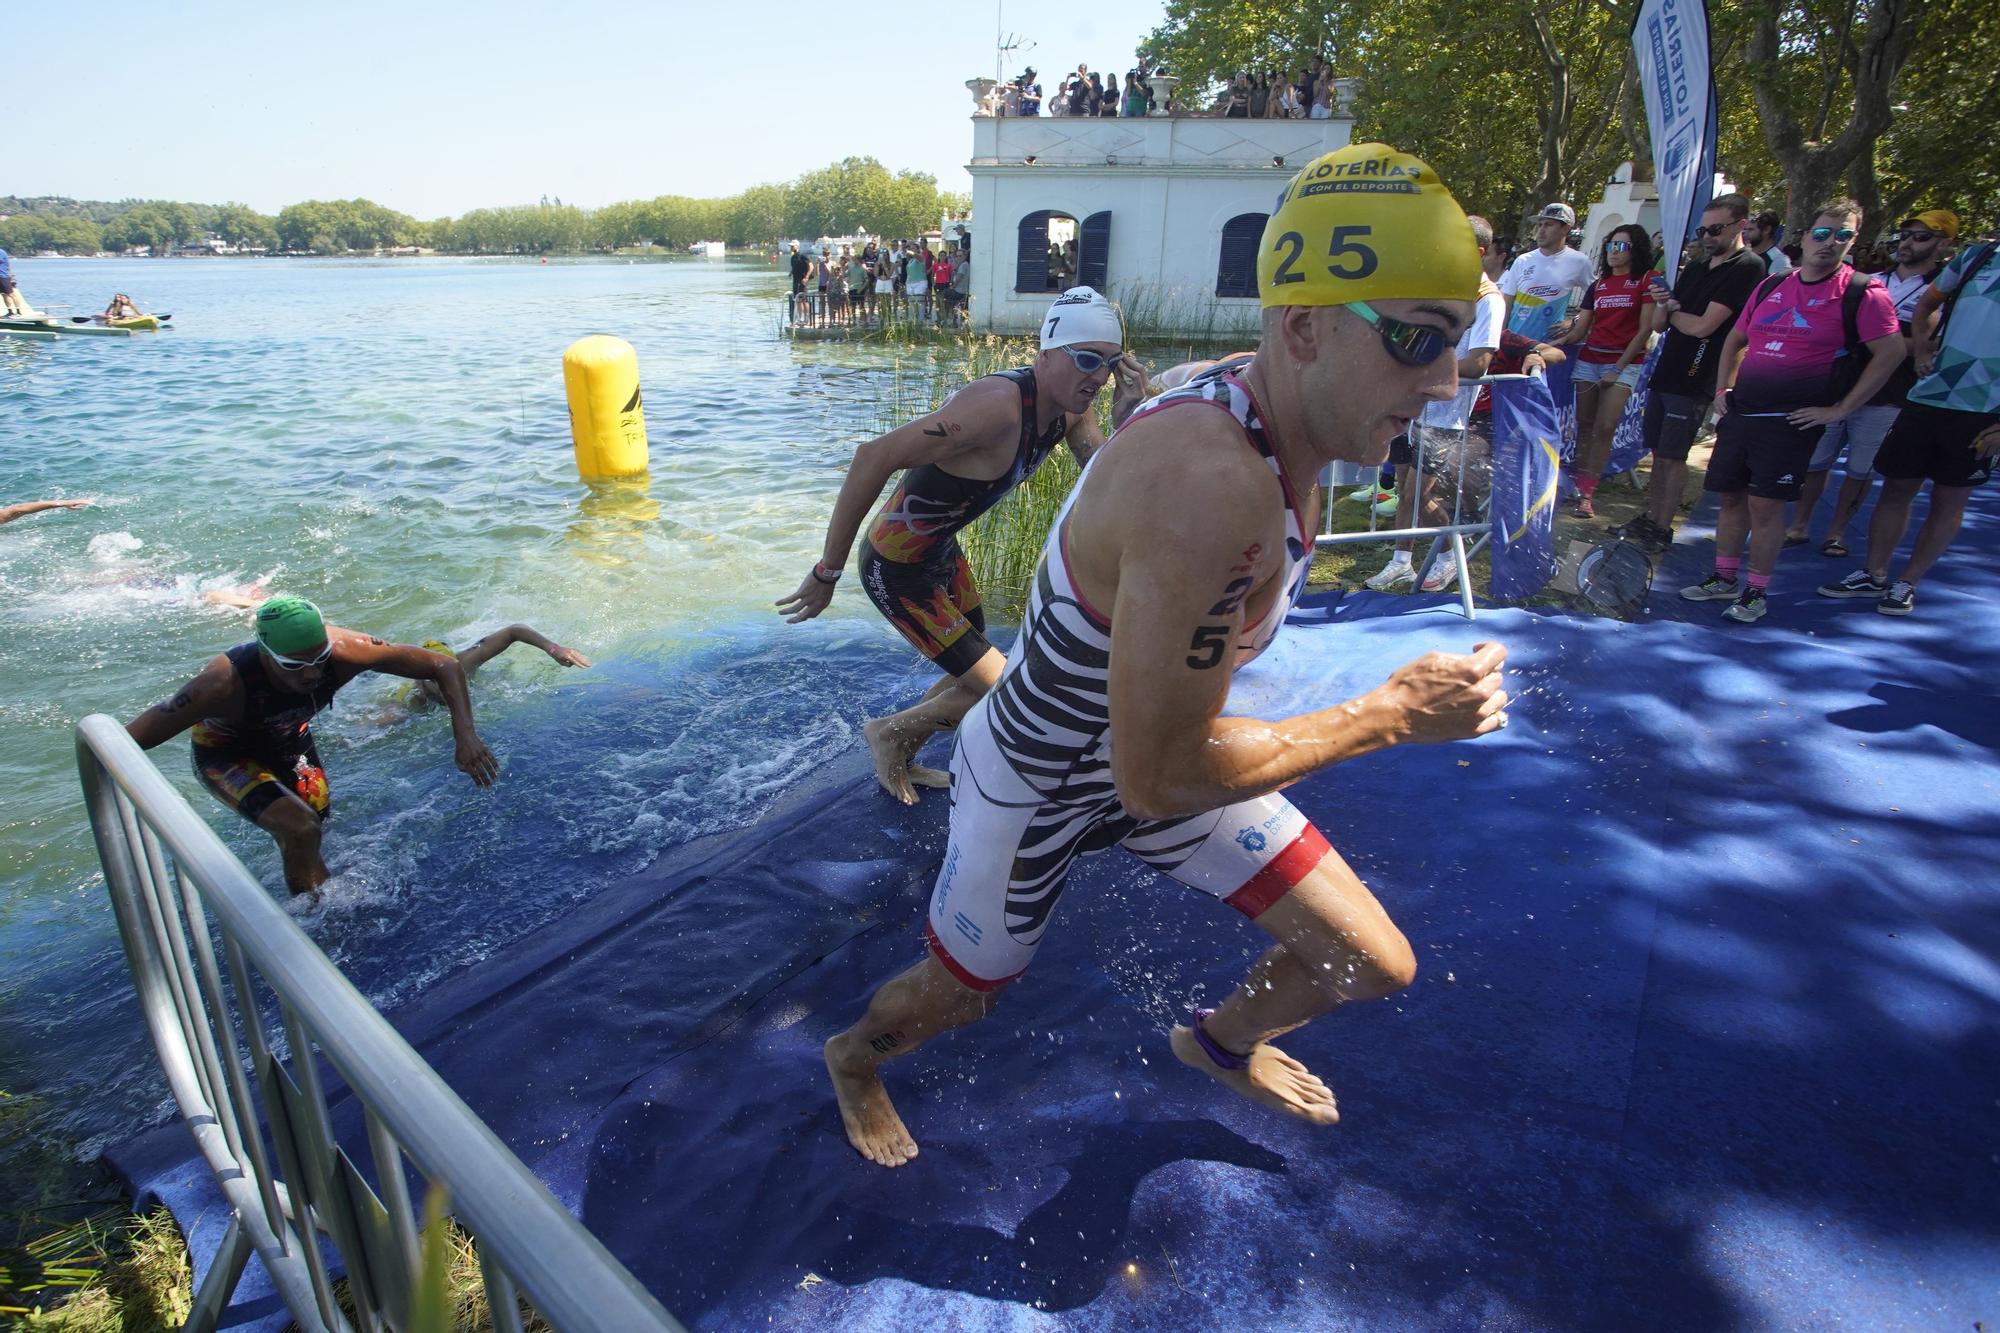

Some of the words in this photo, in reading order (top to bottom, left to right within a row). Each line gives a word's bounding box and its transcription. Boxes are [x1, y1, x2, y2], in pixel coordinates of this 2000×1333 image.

[1306, 158, 1421, 181] LOTERÍAS
[1309, 184, 1333, 193] CON
[1334, 182, 1350, 191] EL
[1352, 182, 1408, 192] DEPORTE
[1048, 316, 1061, 338] 7
